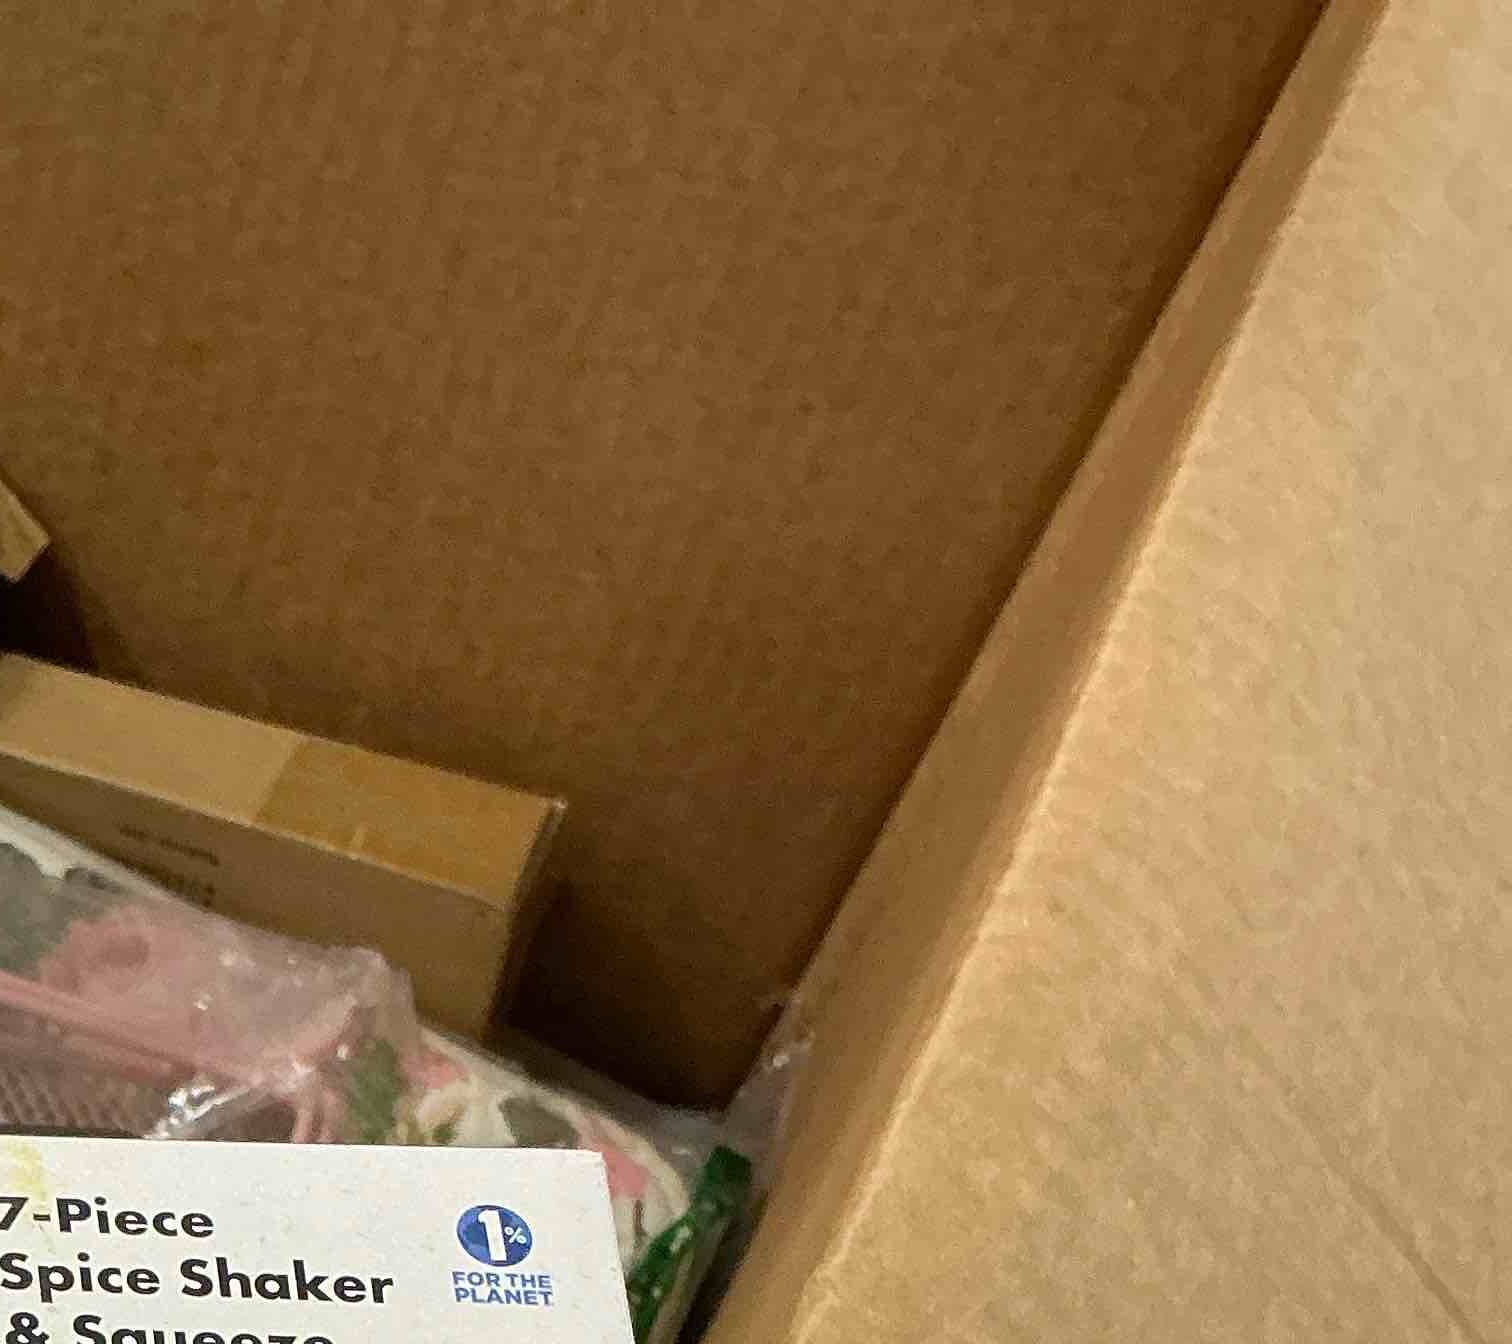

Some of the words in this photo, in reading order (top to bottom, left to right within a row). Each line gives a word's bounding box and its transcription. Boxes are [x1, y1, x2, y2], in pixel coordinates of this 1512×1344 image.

[0, 1252, 160, 1303] Spice
[180, 1257, 393, 1303] Shaker
[452, 1272, 500, 1287] FOR
[505, 1273, 552, 1289] THE
[455, 1288, 553, 1306] PLANET
